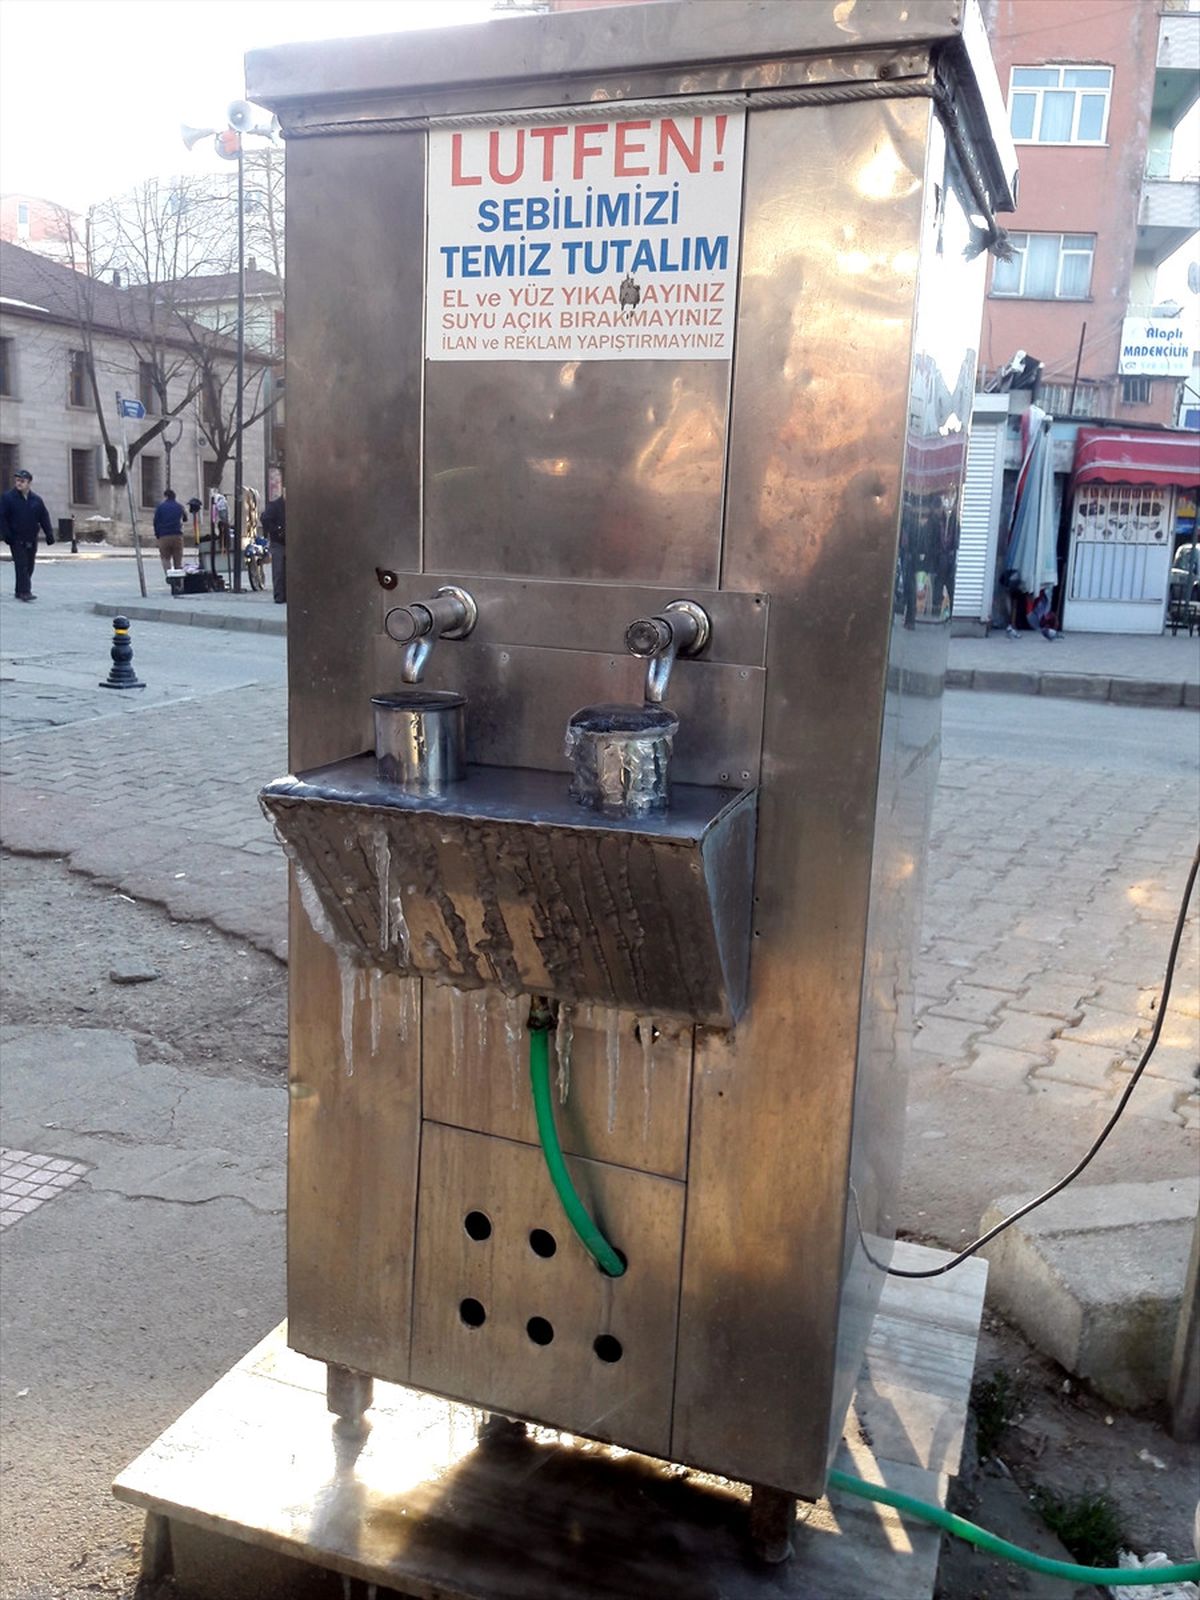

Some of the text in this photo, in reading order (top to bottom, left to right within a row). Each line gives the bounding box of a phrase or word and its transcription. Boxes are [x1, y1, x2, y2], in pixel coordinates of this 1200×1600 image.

[477, 181, 680, 233] SEBİLİMİZİ
[440, 235, 729, 278] TEMİZ TUTALIM
[443, 282, 725, 308] EL ve YÜZ YIKAAYINIZ
[442, 308, 723, 333] SUYU AÇIK BIRAKMAYINIZ
[442, 333, 725, 352] İLAN ve REKLAM YAPIŞTIRMAYINIZ
